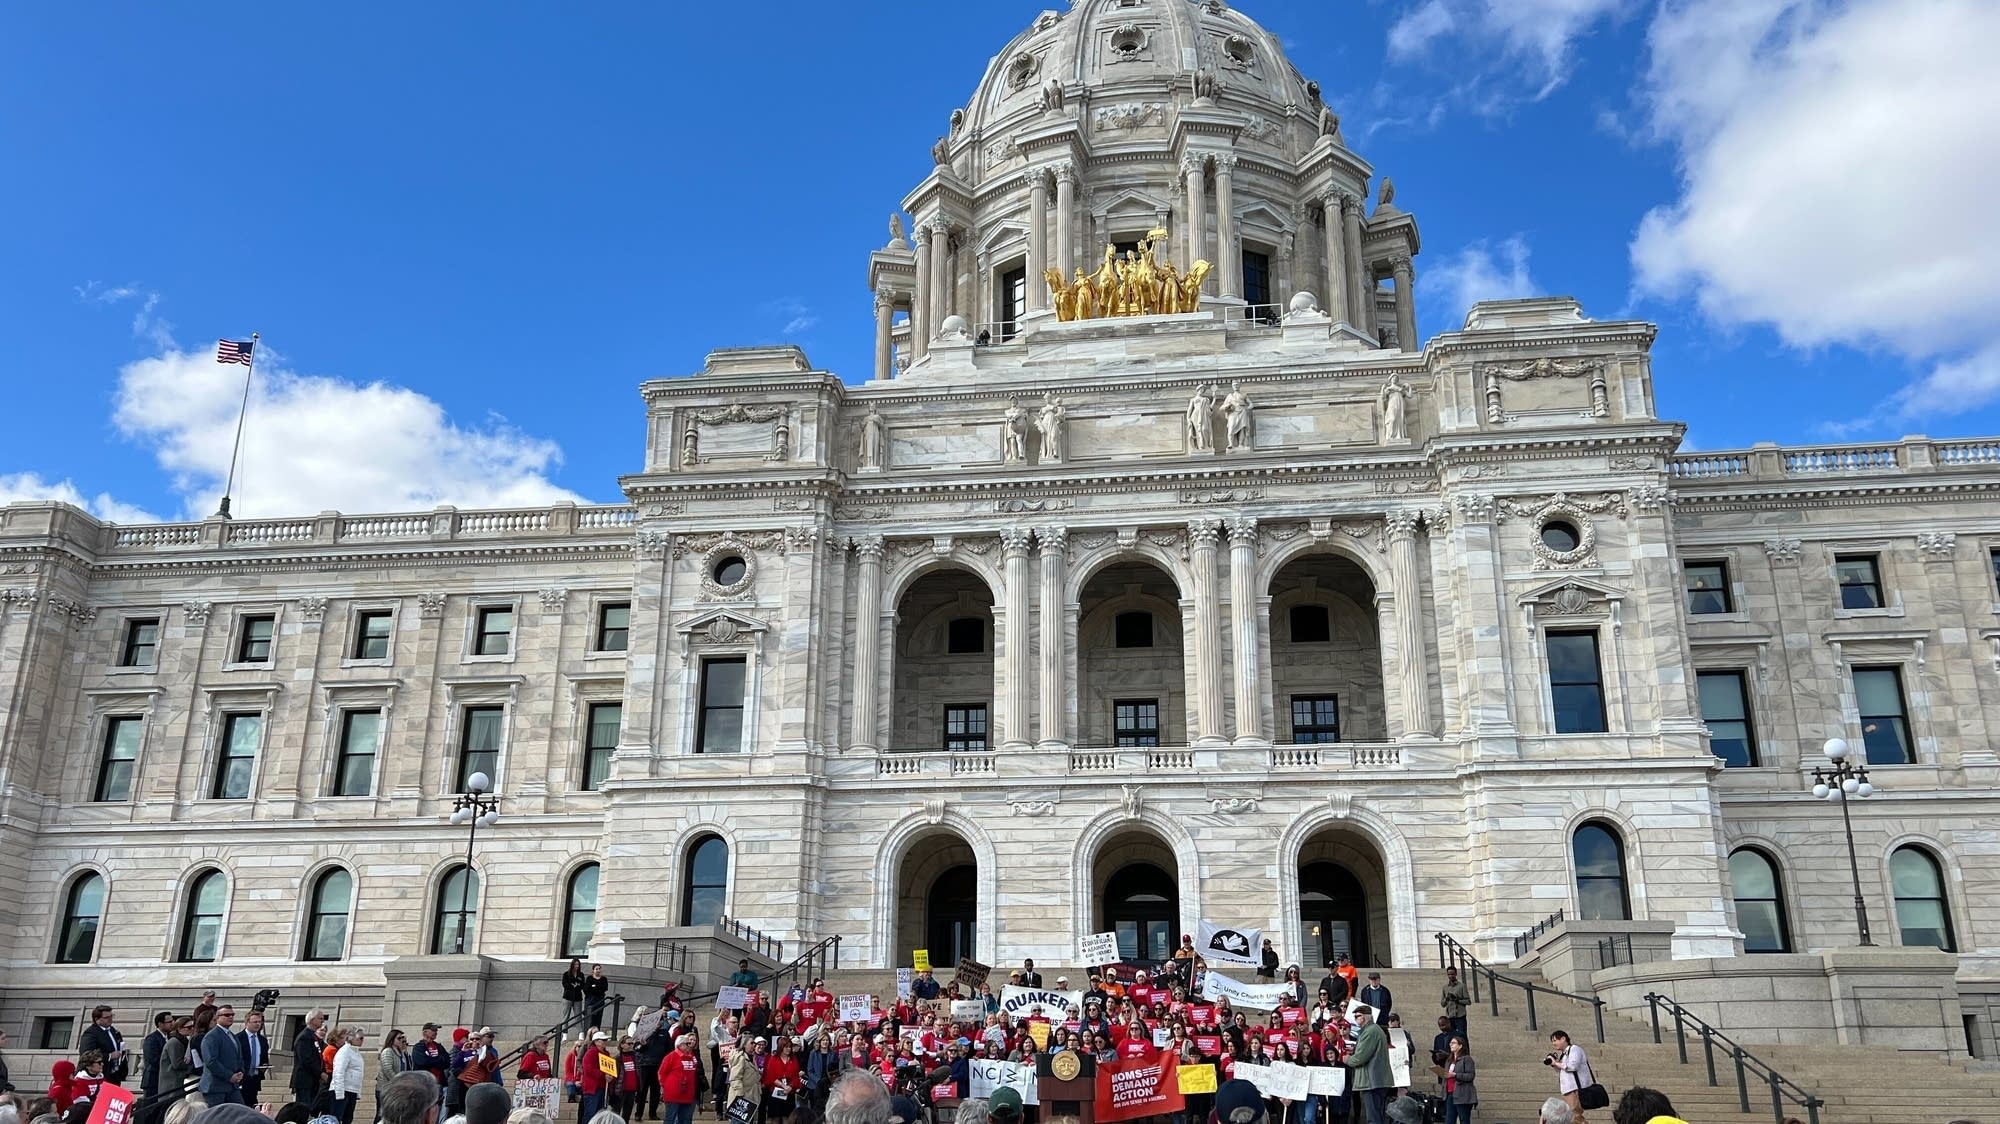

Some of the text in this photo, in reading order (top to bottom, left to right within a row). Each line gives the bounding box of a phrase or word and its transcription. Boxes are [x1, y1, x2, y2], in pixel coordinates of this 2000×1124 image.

[1223, 986, 1239, 997] Unity
[1240, 991, 1264, 1000] Church
[1005, 992, 1070, 1012] QUAKER
[515, 1078, 560, 1088] PROTECT
[1111, 1069, 1143, 1083] MOMS
[1112, 1076, 1158, 1093] DEMAND
[1113, 1087, 1154, 1102] ACTION
